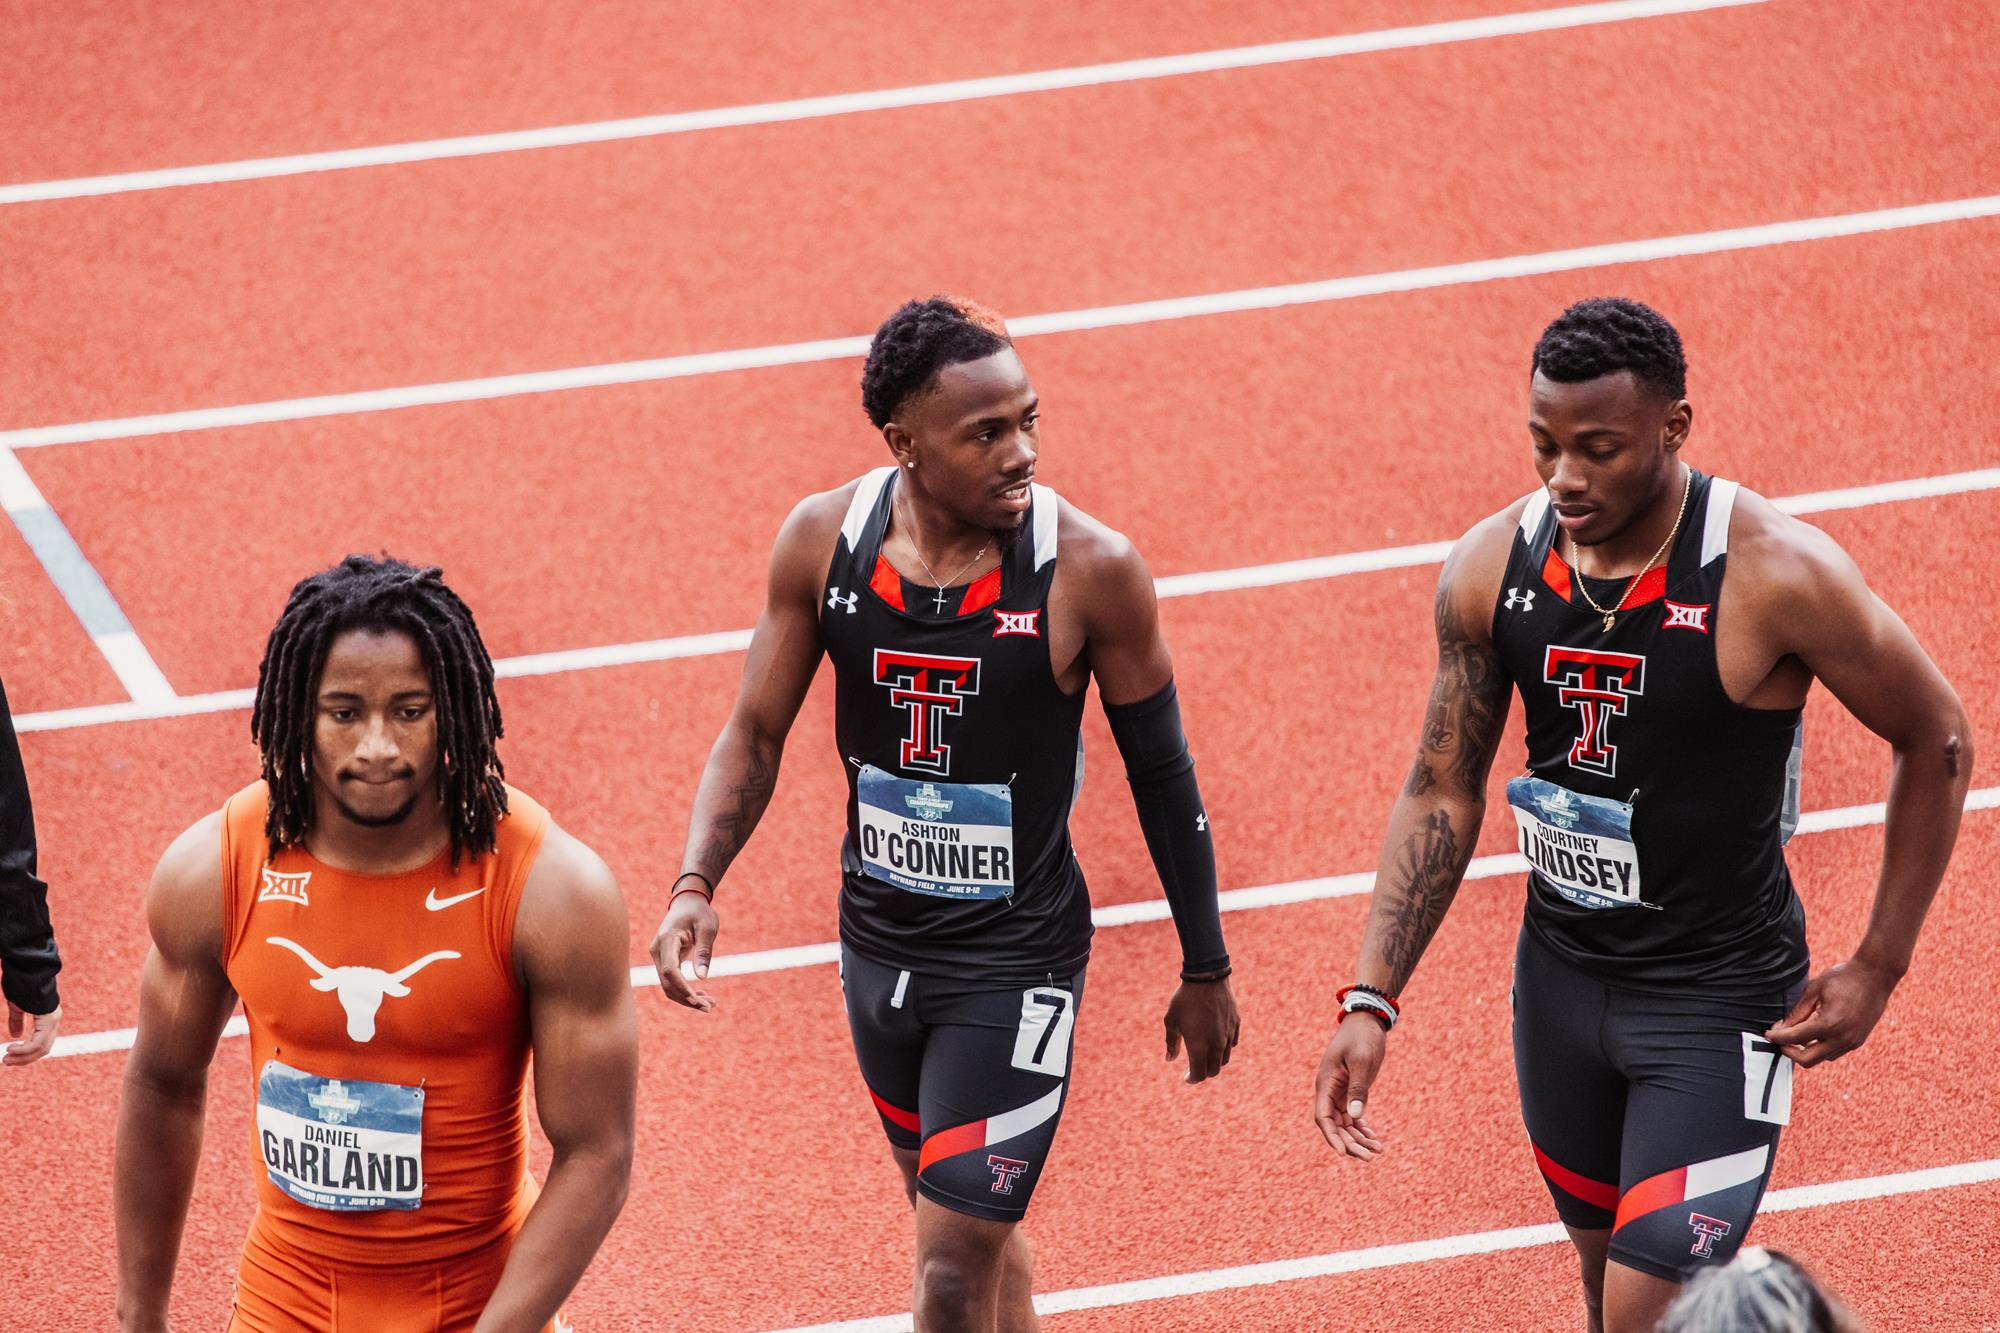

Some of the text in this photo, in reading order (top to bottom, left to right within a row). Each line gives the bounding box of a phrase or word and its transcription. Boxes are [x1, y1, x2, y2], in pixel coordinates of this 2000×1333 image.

[862, 824, 1010, 881] O'CONNER
[902, 821, 960, 843] ASHTON
[1537, 822, 1599, 854] COURTNEY
[917, 881, 936, 890] FIELD
[946, 885, 965, 893] JUNE
[1522, 826, 1632, 896] LINDSEY
[1031, 993, 1066, 1064] 7
[1751, 1040, 1782, 1114] 7
[262, 1129, 418, 1192] GARLAND
[305, 1124, 362, 1149] DANIEL
